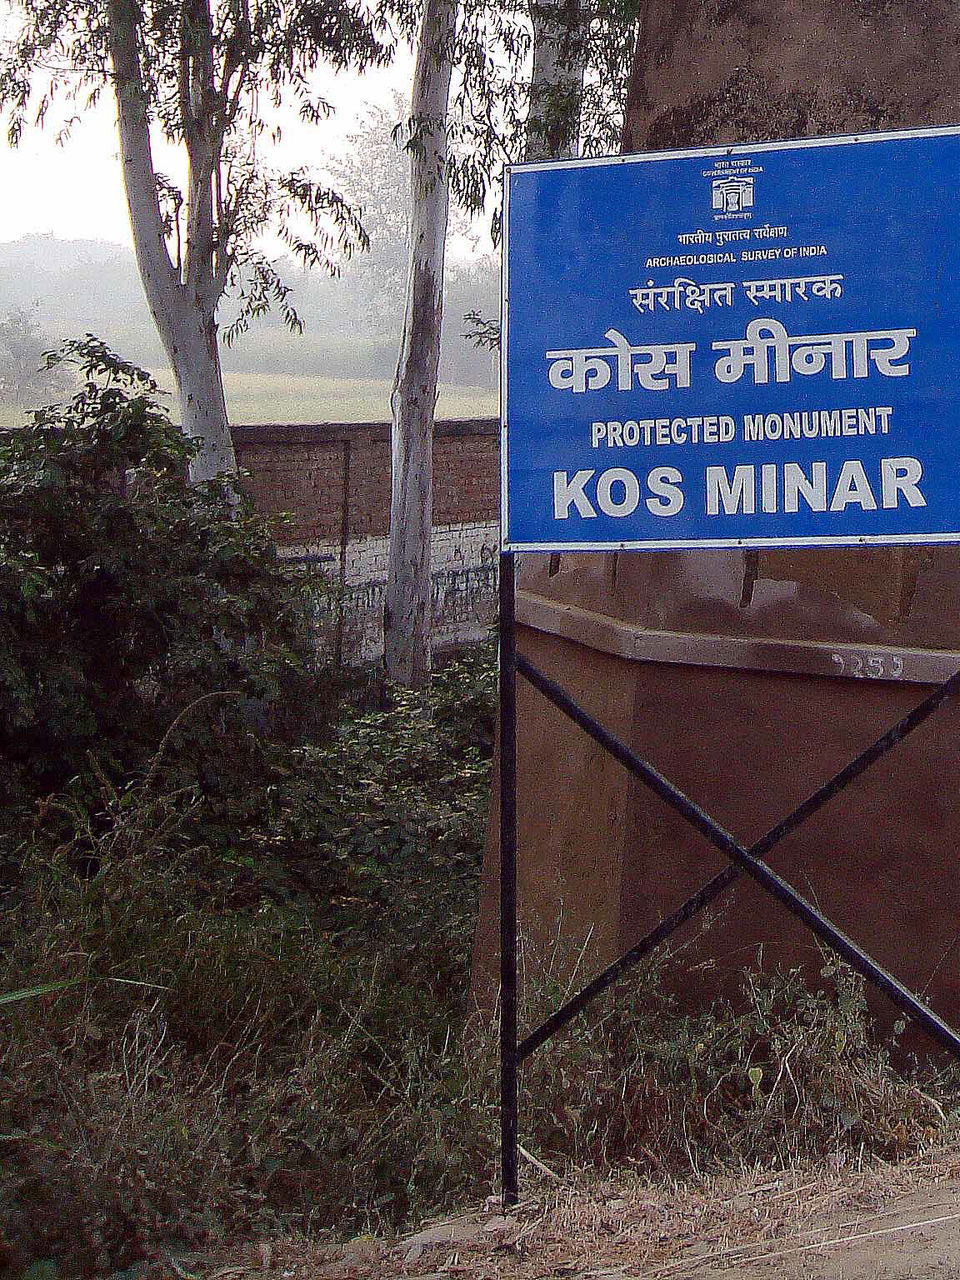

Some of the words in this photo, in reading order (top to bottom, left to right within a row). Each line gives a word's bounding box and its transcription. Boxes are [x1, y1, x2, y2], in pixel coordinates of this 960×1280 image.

[702, 168, 740, 177] GOVERNMENT
[677, 228, 713, 245] भारतीय
[715, 227, 751, 246] पुरातत्व
[754, 223, 788, 239] सर्वेक्षण
[645, 253, 737, 268] ARCHAEOLOGICAL
[741, 248, 781, 262] SURVEY
[783, 247, 798, 258] OF
[800, 245, 828, 257] INDIA
[629, 277, 736, 315] संरक्षित
[742, 273, 844, 306] स्मारक
[546, 328, 697, 393] कोस
[712, 318, 917, 384] मीनार
[591, 416, 736, 448] PROTECTED
[743, 406, 893, 442] MONUMENT
[553, 466, 685, 520] KOS
[706, 456, 928, 516] MINAR
